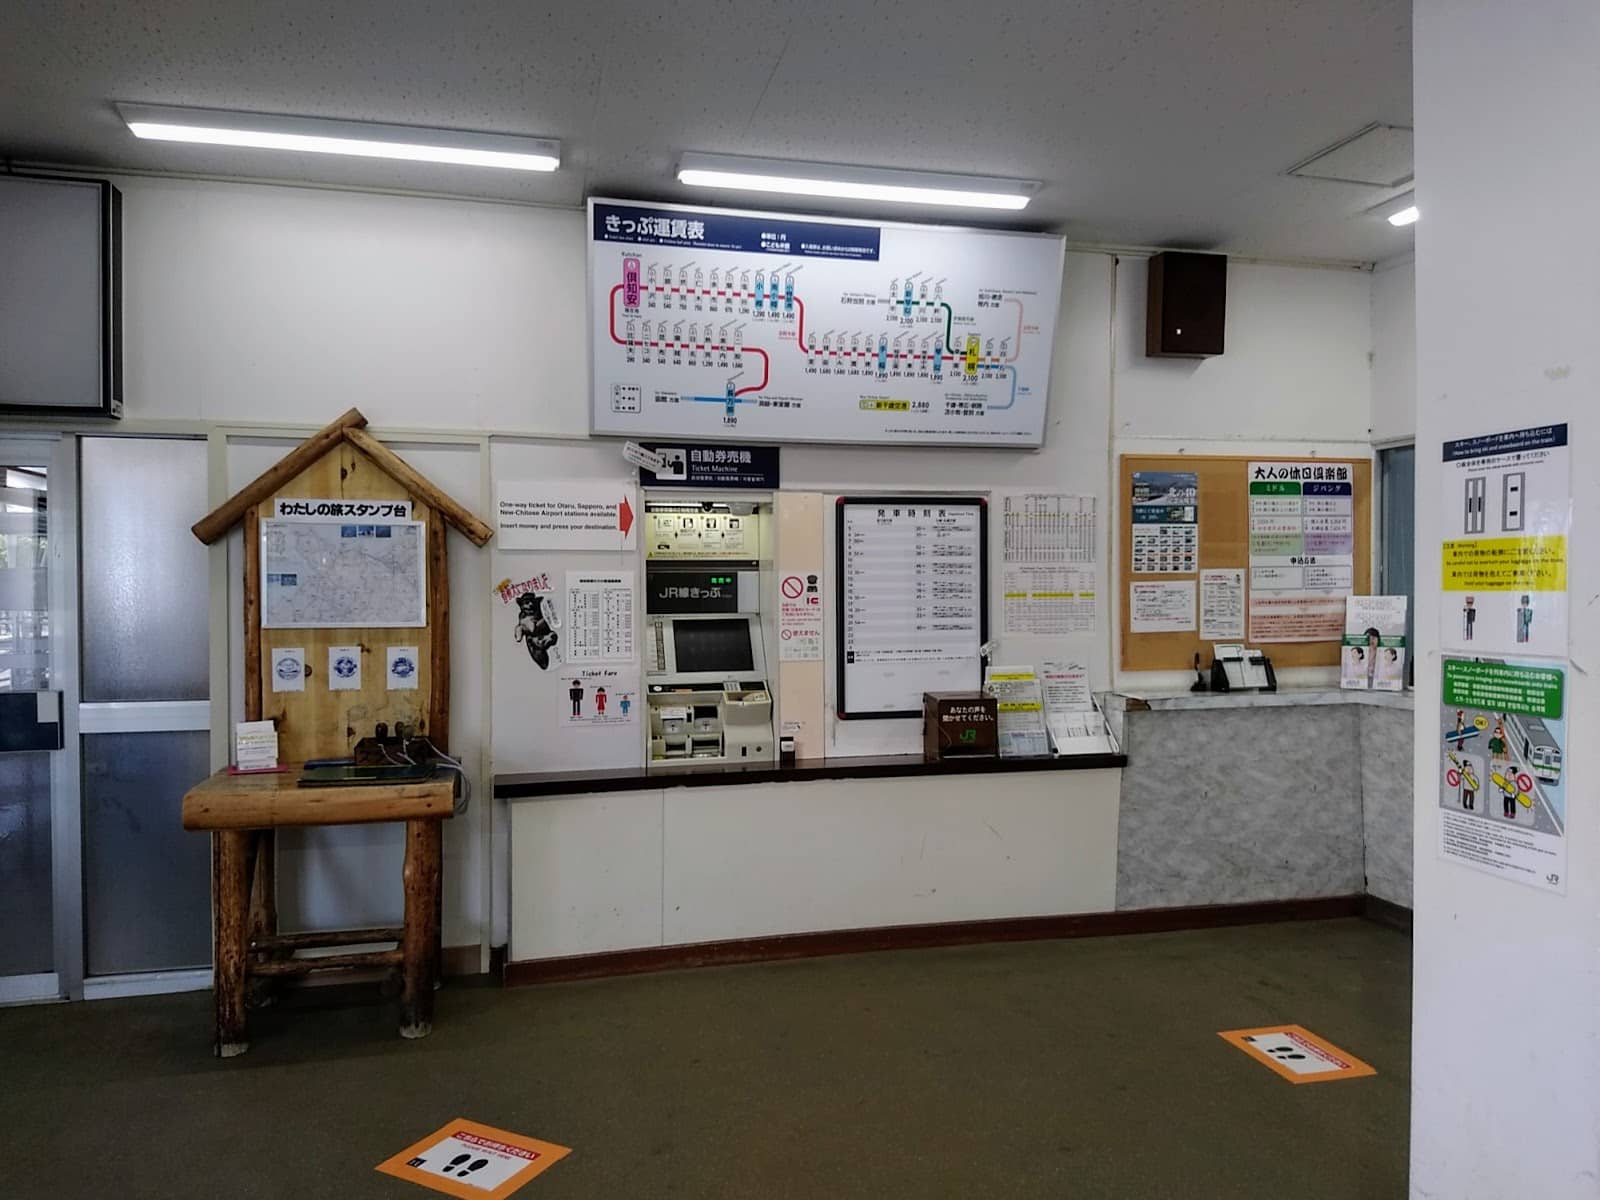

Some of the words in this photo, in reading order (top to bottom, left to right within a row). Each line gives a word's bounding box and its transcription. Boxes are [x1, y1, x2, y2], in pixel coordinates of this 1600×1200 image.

[605, 214, 705, 241] きっぷ運賃表
[627, 271, 638, 304] 倶知安
[691, 450, 752, 463] 自動券売機
[692, 464, 710, 472] Ticket
[711, 464, 738, 472] Machine
[1254, 466, 1348, 480] 大人の休日倶楽部
[1266, 484, 1285, 492] ミドル
[1313, 484, 1342, 492] ジパング
[280, 502, 407, 518] わたしの旅スタンプ台
[807, 597, 819, 605] IC
[950, 706, 986, 714] あなたの声を
[942, 714, 994, 722] 聞かせてください。
[960, 729, 977, 741] JR
